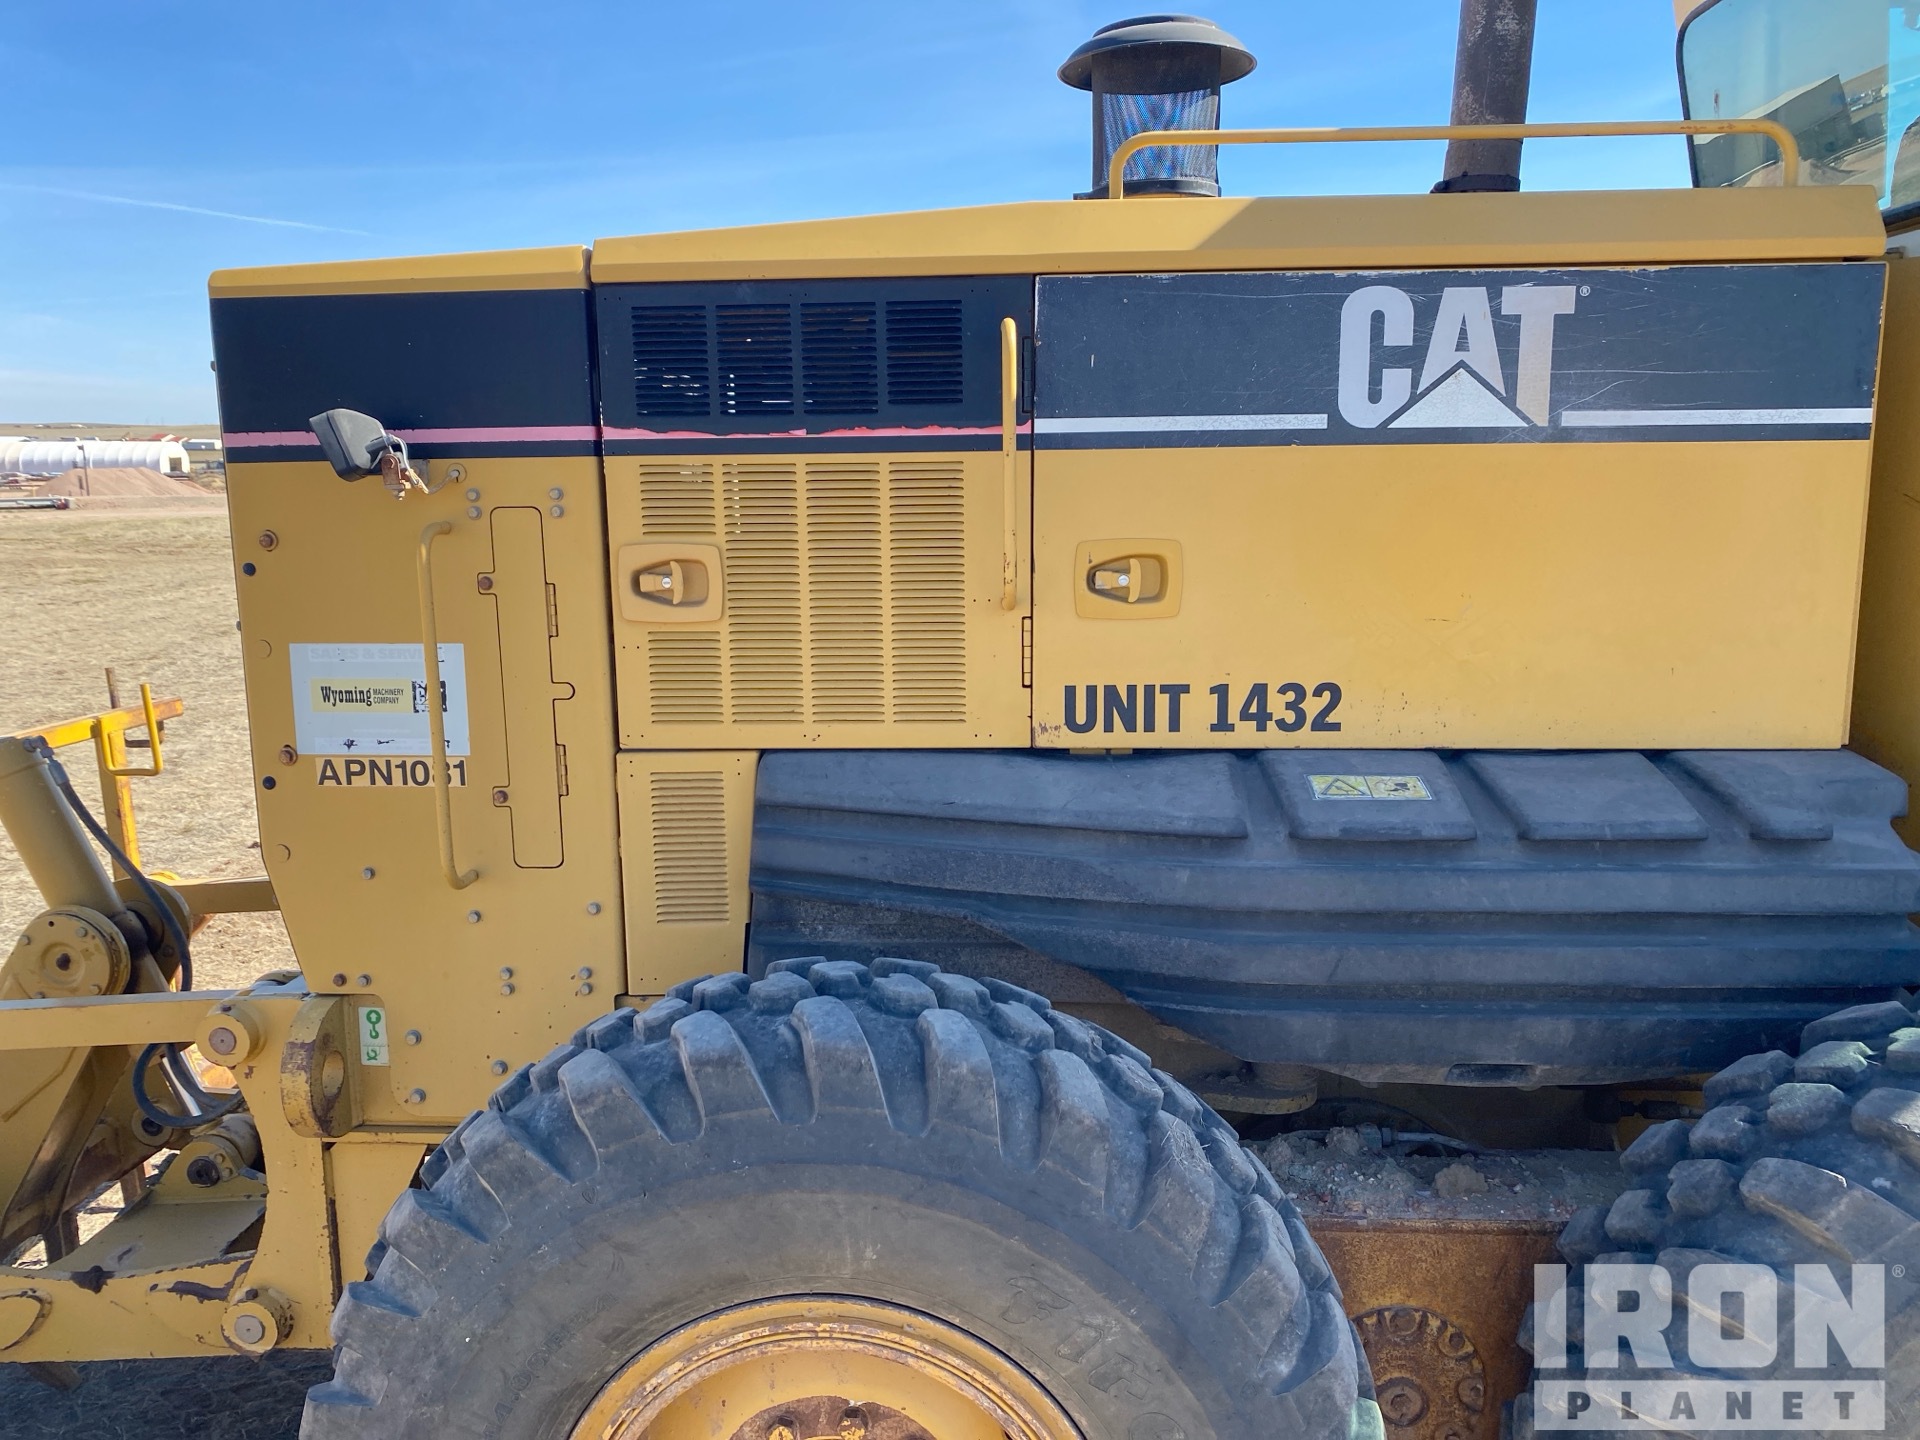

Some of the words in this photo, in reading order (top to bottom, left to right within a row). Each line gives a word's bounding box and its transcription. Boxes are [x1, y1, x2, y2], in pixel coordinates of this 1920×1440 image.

[1338, 285, 1575, 428] CAT
[320, 686, 373, 707] Wyoming
[373, 688, 404, 696] MACHINERY
[373, 697, 399, 705] COMPANY
[1063, 683, 1190, 735] UNIT
[1207, 681, 1343, 734] 1432
